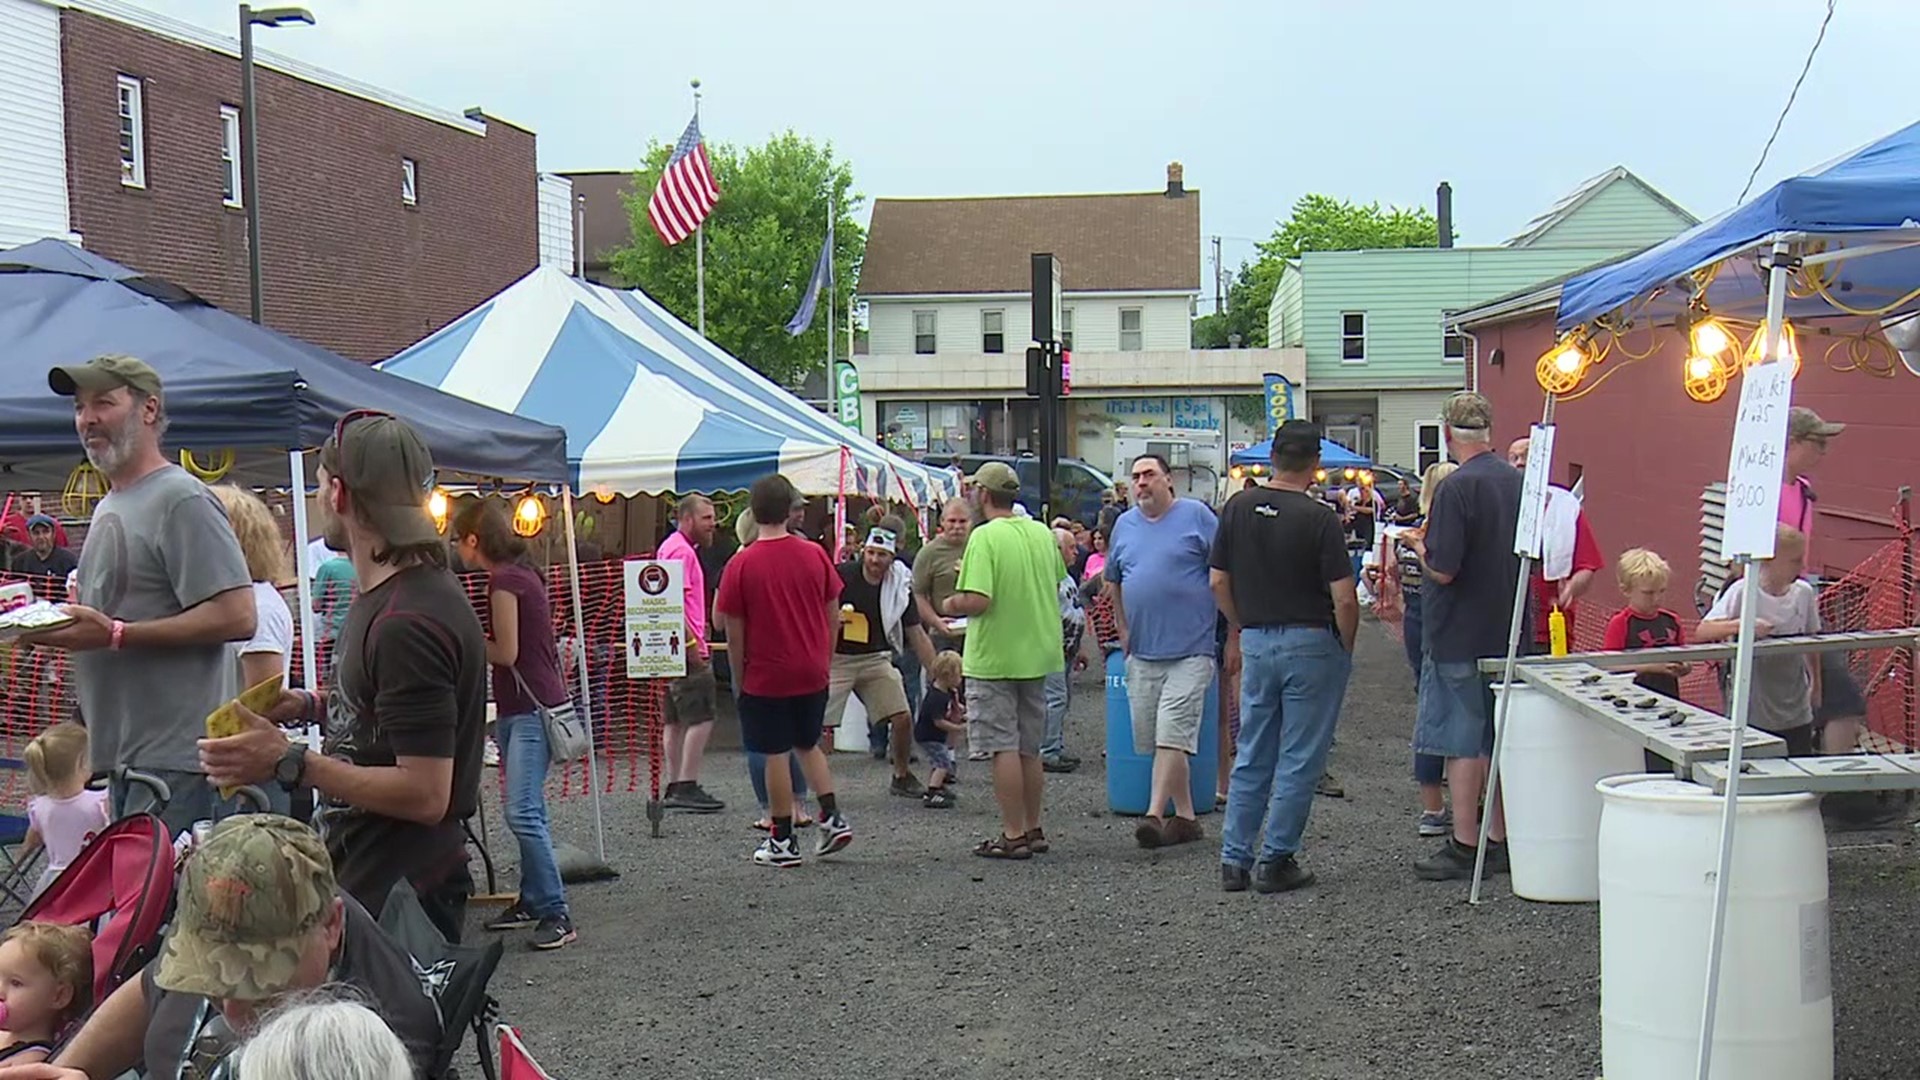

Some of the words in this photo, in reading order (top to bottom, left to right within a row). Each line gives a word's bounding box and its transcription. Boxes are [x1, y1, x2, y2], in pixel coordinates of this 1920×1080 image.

[840, 367, 860, 434] CB
[1141, 400, 1165, 413] Pool
[1184, 398, 1207, 416] Spa
[1175, 414, 1219, 430] Supply
[1758, 443, 1777, 469] Bet
[627, 606, 682, 615] RECOMMENDED
[629, 622, 681, 632] REMEMBER
[640, 655, 673, 664] SOCIAL
[628, 663, 684, 673] DISTANCING
[1818, 758, 1882, 773] 2
